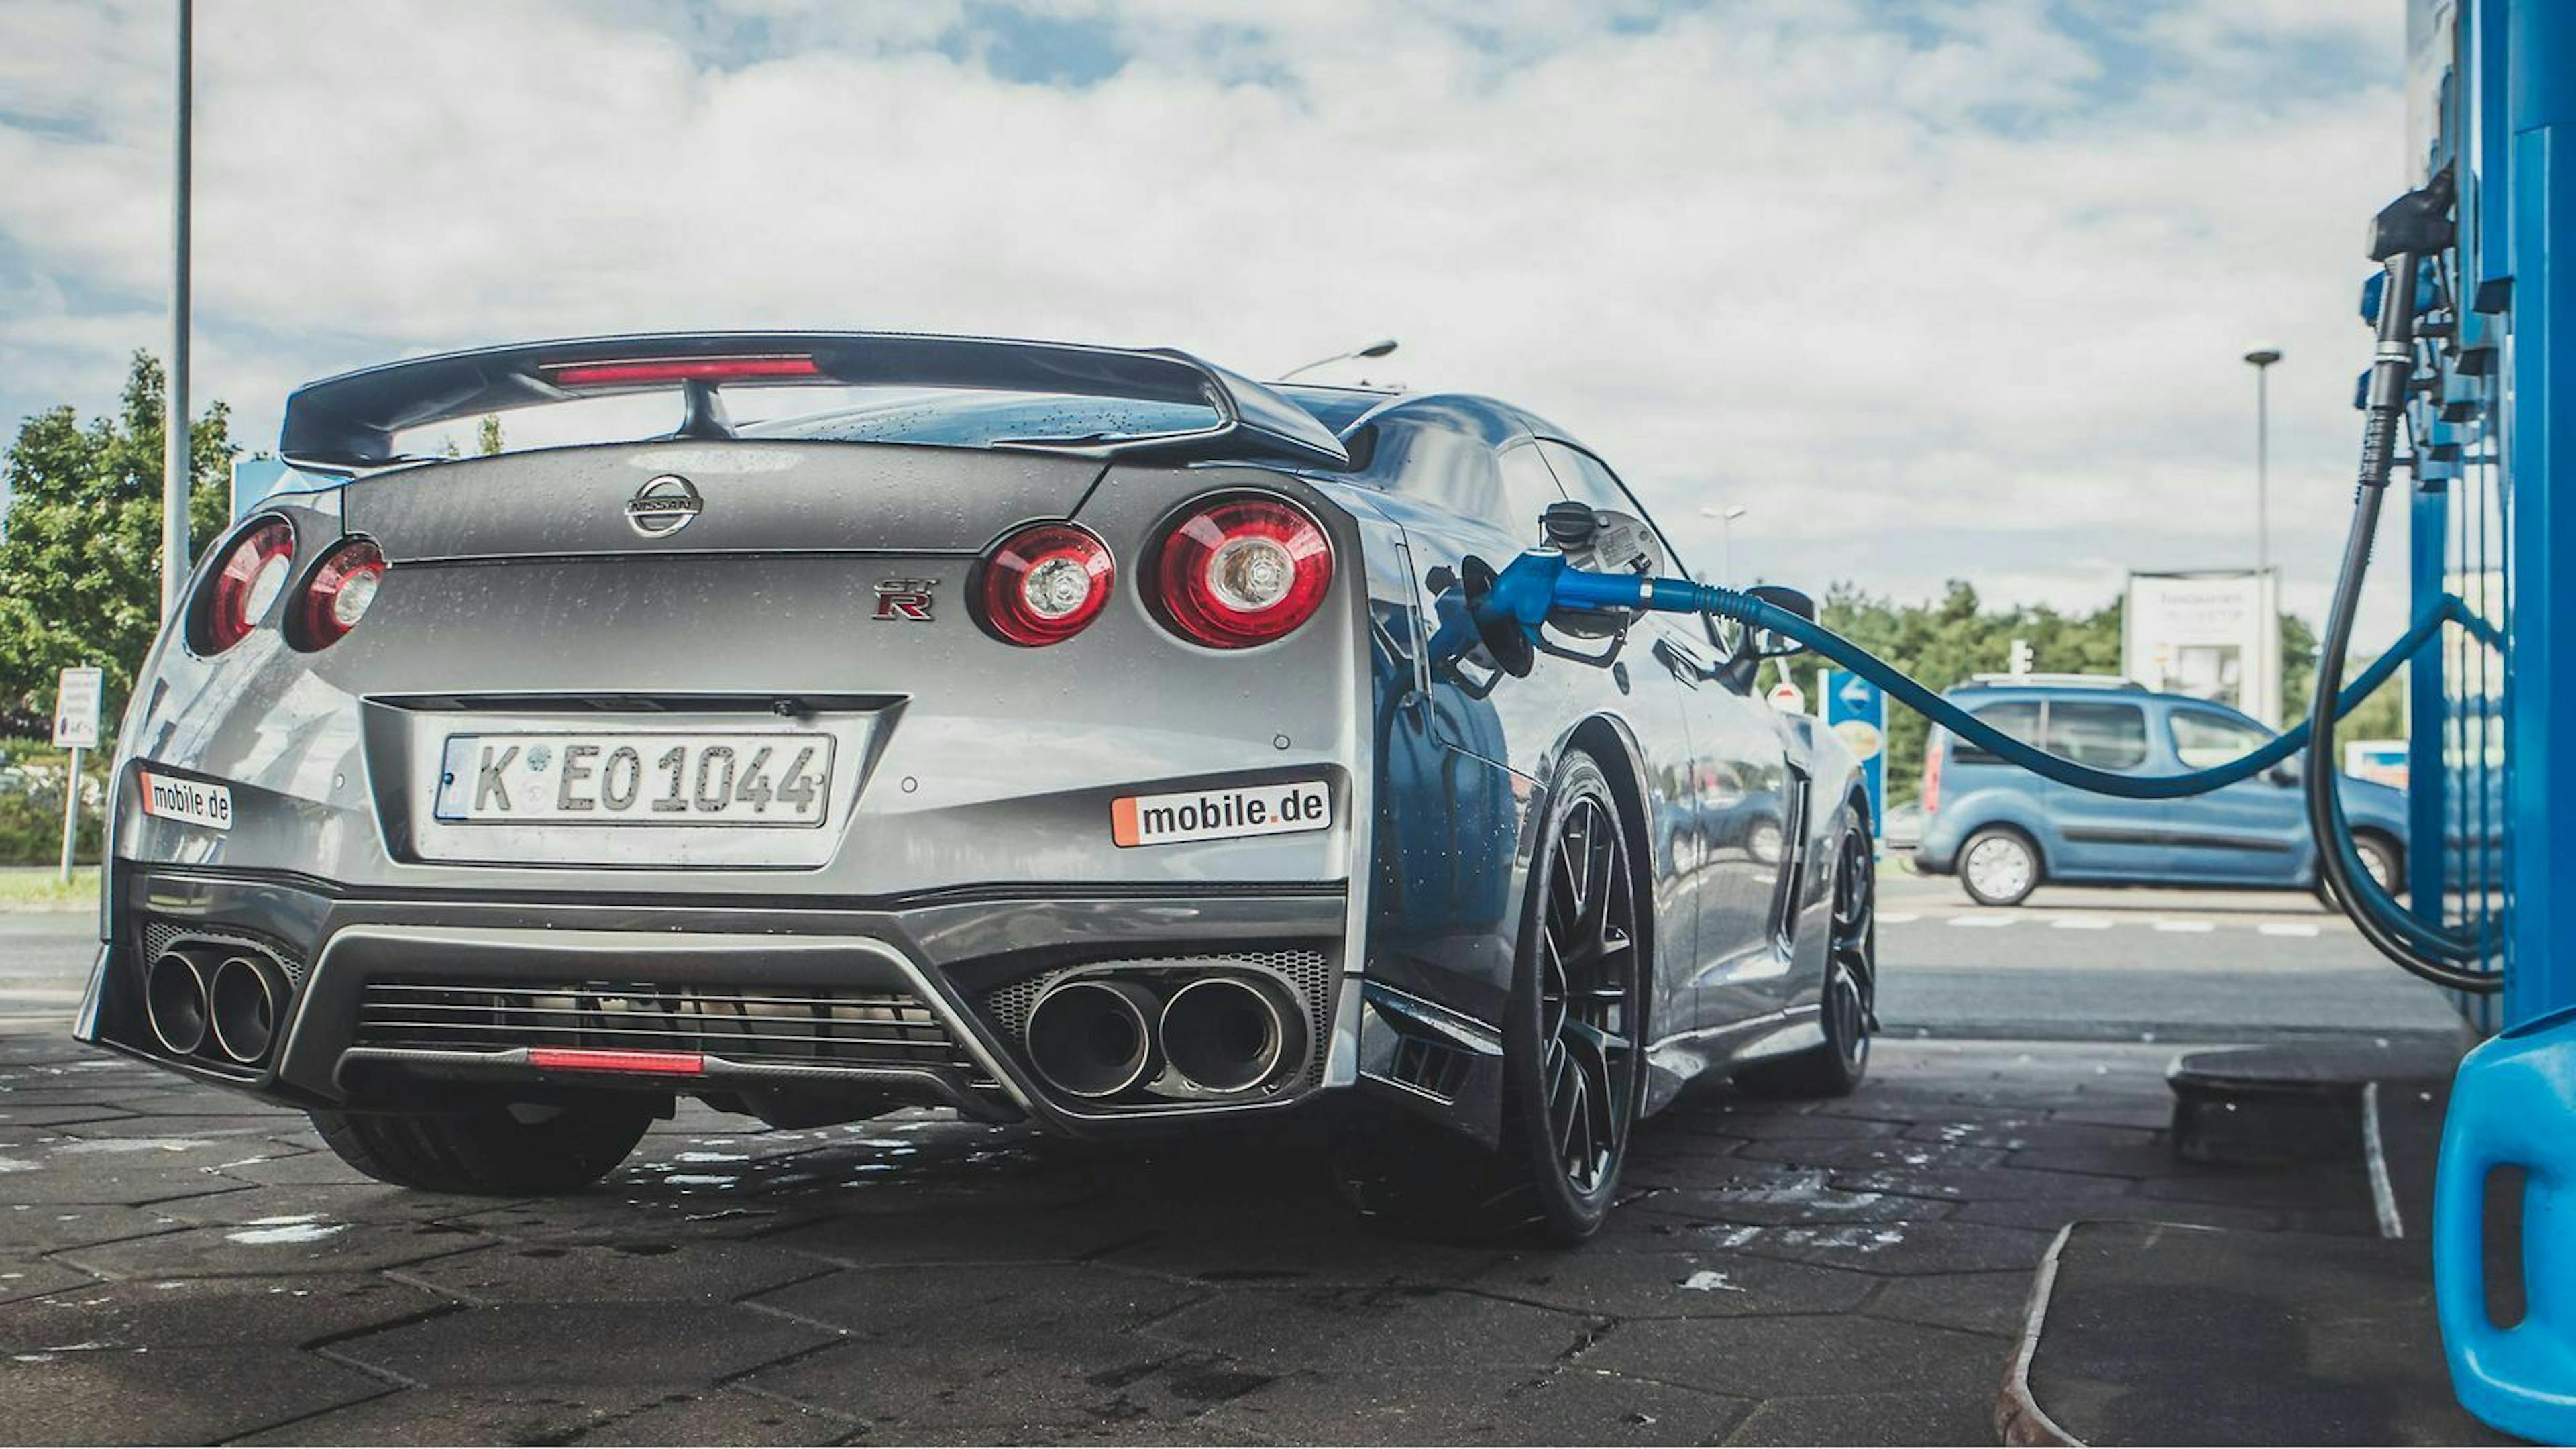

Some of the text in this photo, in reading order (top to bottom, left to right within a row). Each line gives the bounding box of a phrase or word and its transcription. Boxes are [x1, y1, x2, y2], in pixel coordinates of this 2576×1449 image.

[631, 500, 692, 511] NISSAN
[474, 746, 519, 811] K
[154, 784, 228, 820] mobile.de
[1143, 789, 1323, 834] mobile.de
